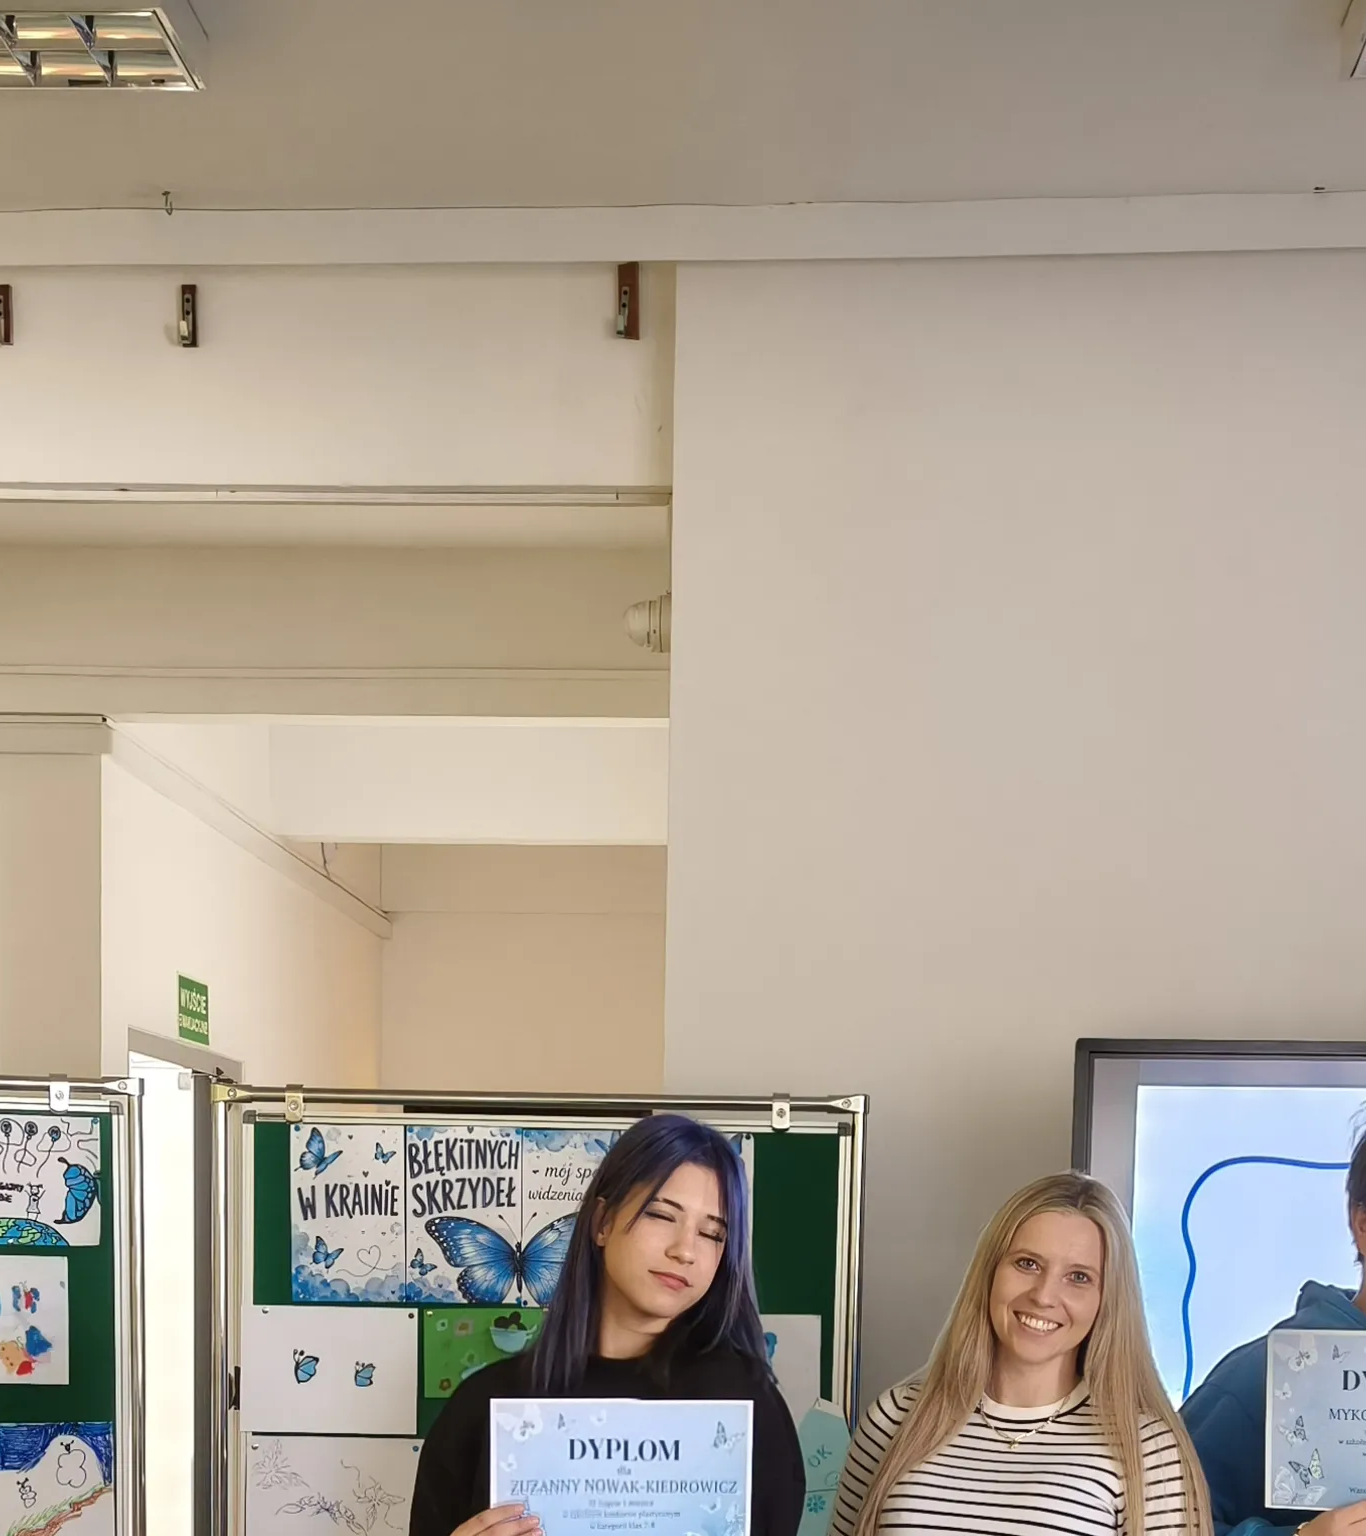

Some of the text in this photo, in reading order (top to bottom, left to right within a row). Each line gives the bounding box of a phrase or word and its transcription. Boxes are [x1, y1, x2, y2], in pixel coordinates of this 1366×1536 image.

[544, 1163, 571, 1185] mój
[297, 1185, 317, 1220] W
[411, 1176, 516, 1218] SKRZYDEŁ
[528, 1185, 583, 1201] widzenia
[569, 1438, 681, 1461] DYPLOM
[617, 1465, 632, 1476] dla
[511, 1479, 738, 1496] ZUZANNY NOWAK-KIEDROWICZ
